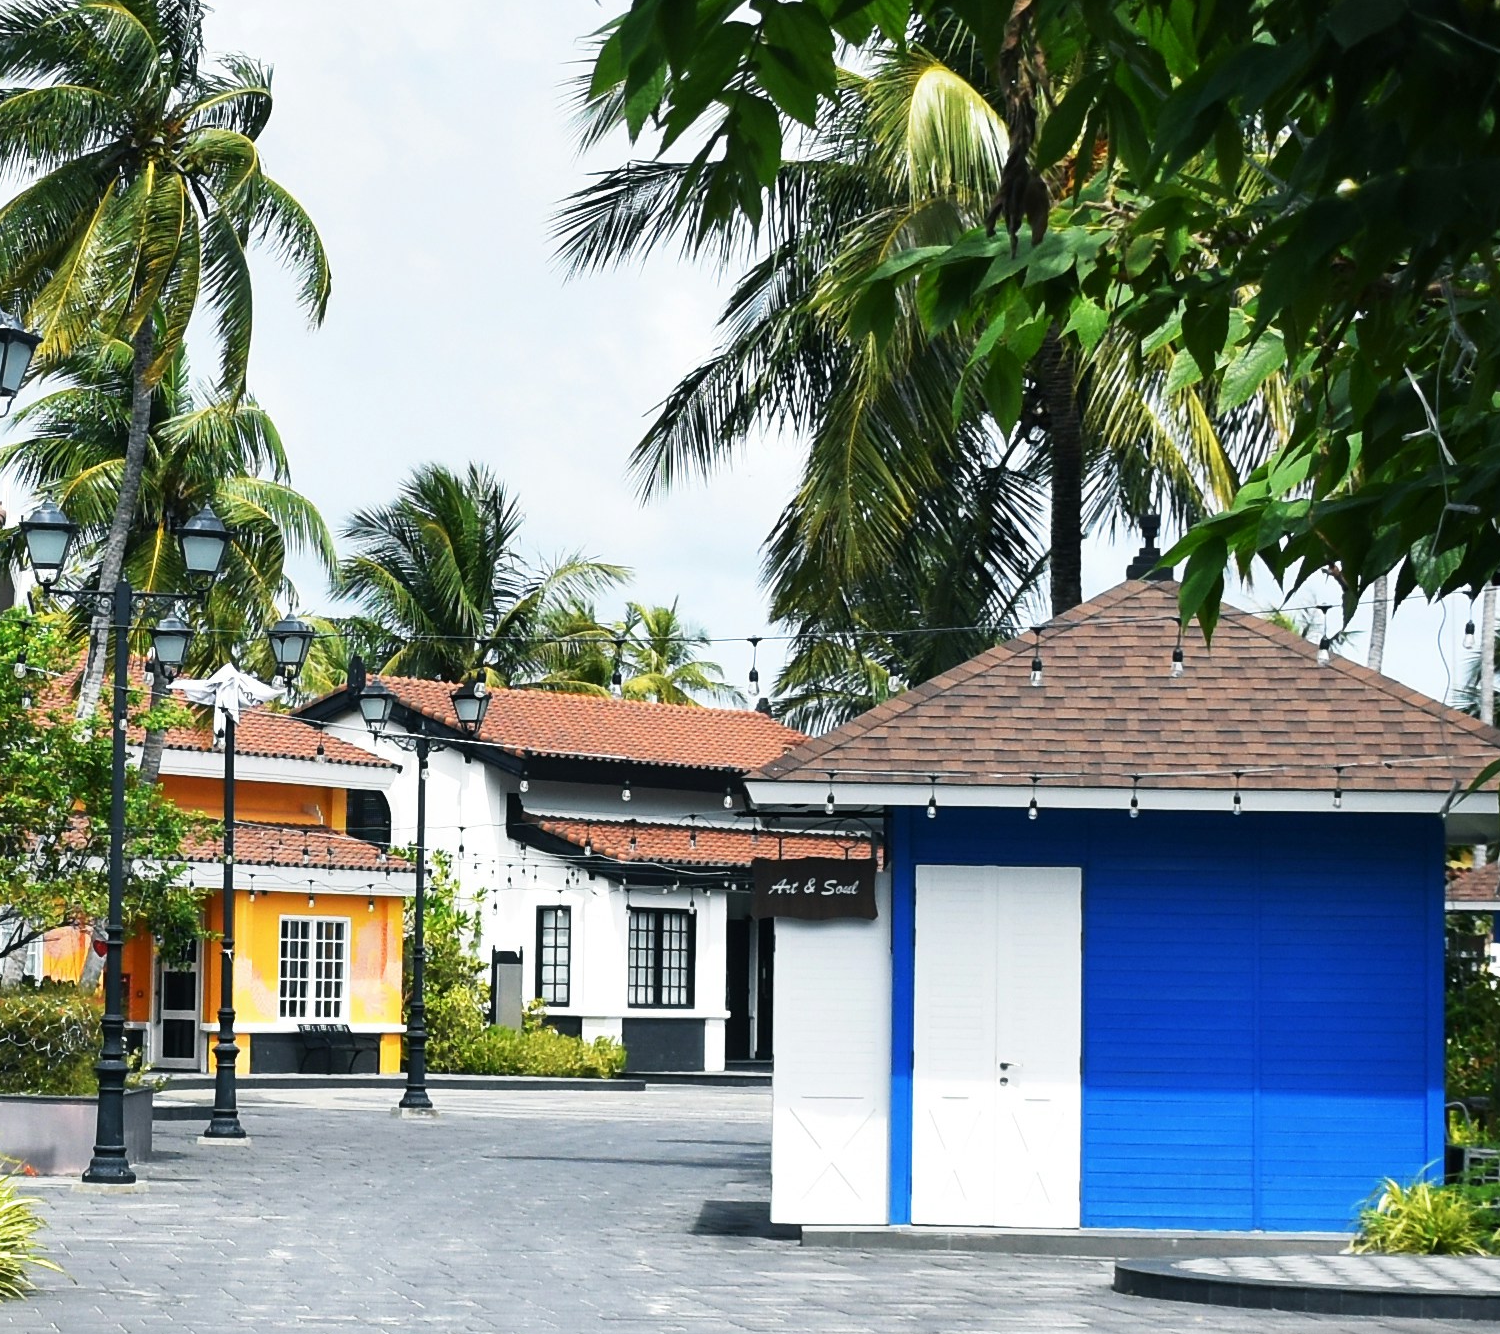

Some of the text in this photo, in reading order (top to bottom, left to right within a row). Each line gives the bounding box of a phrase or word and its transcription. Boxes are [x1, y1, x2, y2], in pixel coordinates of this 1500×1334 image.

[768, 877, 859, 896] Art & Soul
